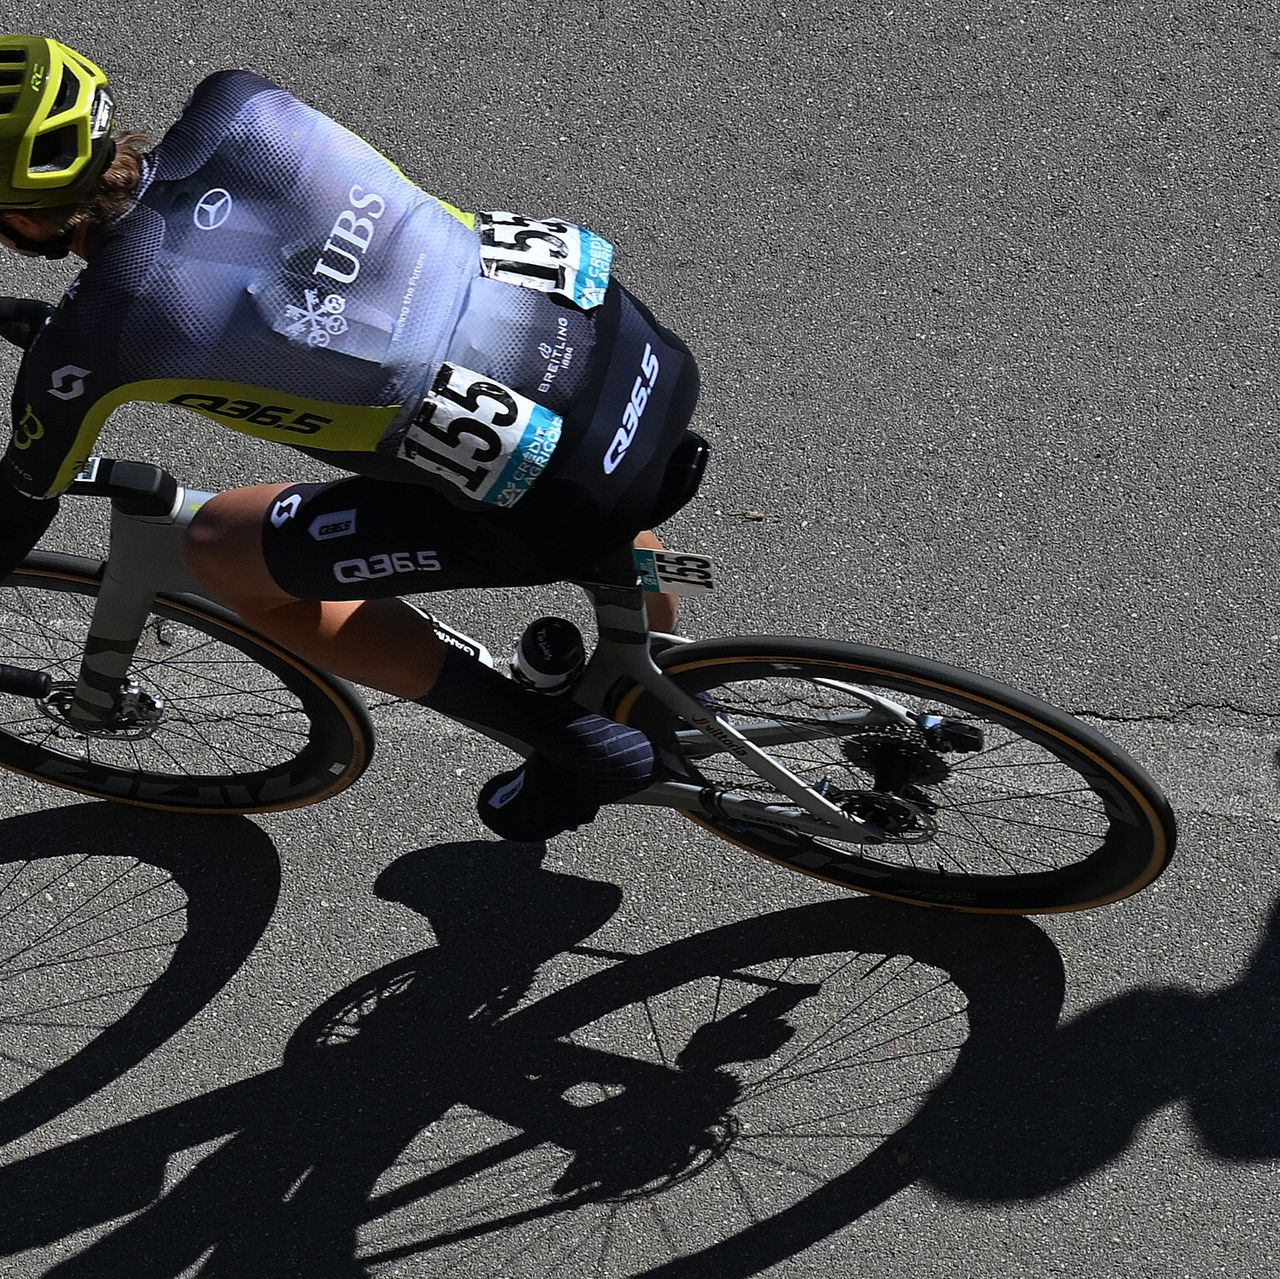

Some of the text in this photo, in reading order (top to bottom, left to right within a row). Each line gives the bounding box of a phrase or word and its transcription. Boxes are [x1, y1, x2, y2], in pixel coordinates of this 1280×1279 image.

[312, 183, 385, 284] UBS
[537, 316, 569, 394] BREITLING
[168, 393, 334, 435] Q36.5
[400, 361, 519, 493] 155
[602, 342, 660, 476] Q36.5
[332, 550, 443, 585] Q36.5
[655, 553, 715, 590] 155
[704, 723, 748, 757] vittoria
